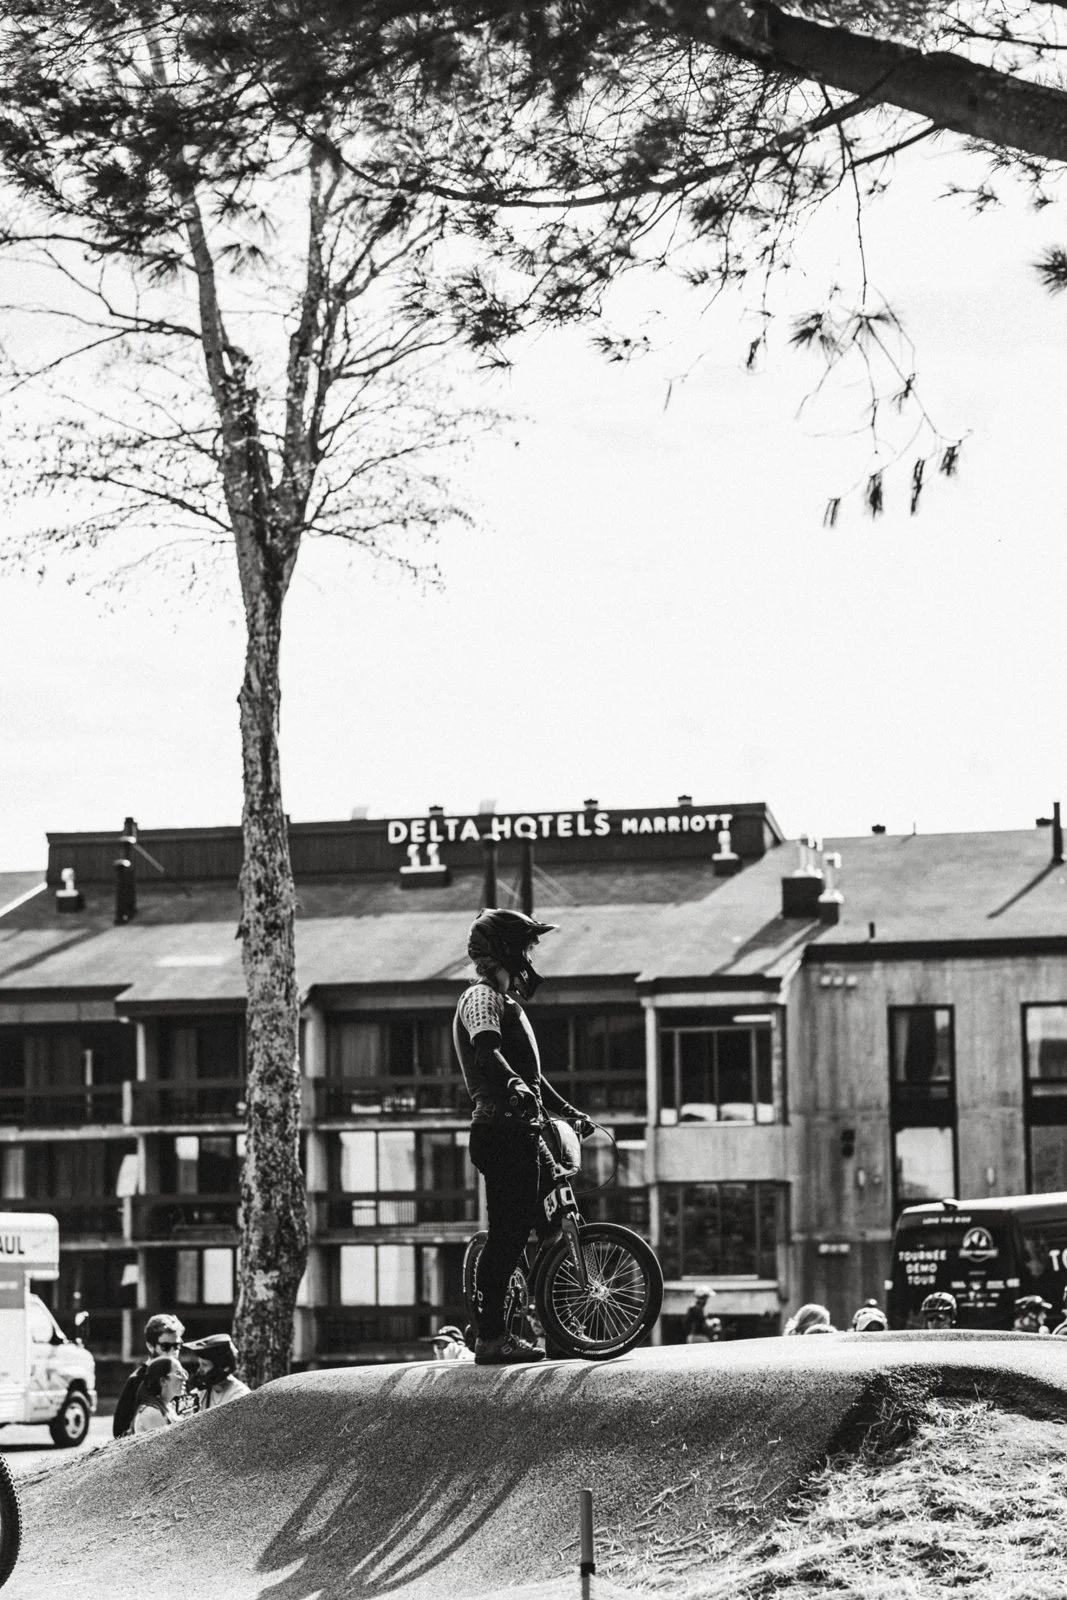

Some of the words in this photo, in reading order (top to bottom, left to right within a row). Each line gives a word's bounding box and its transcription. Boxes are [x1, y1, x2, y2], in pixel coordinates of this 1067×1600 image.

[388, 818, 481, 844] DELTA
[491, 812, 611, 840] HOTELS
[622, 813, 733, 834] MARRIOTT
[908, 1275, 936, 1285] TOUR
